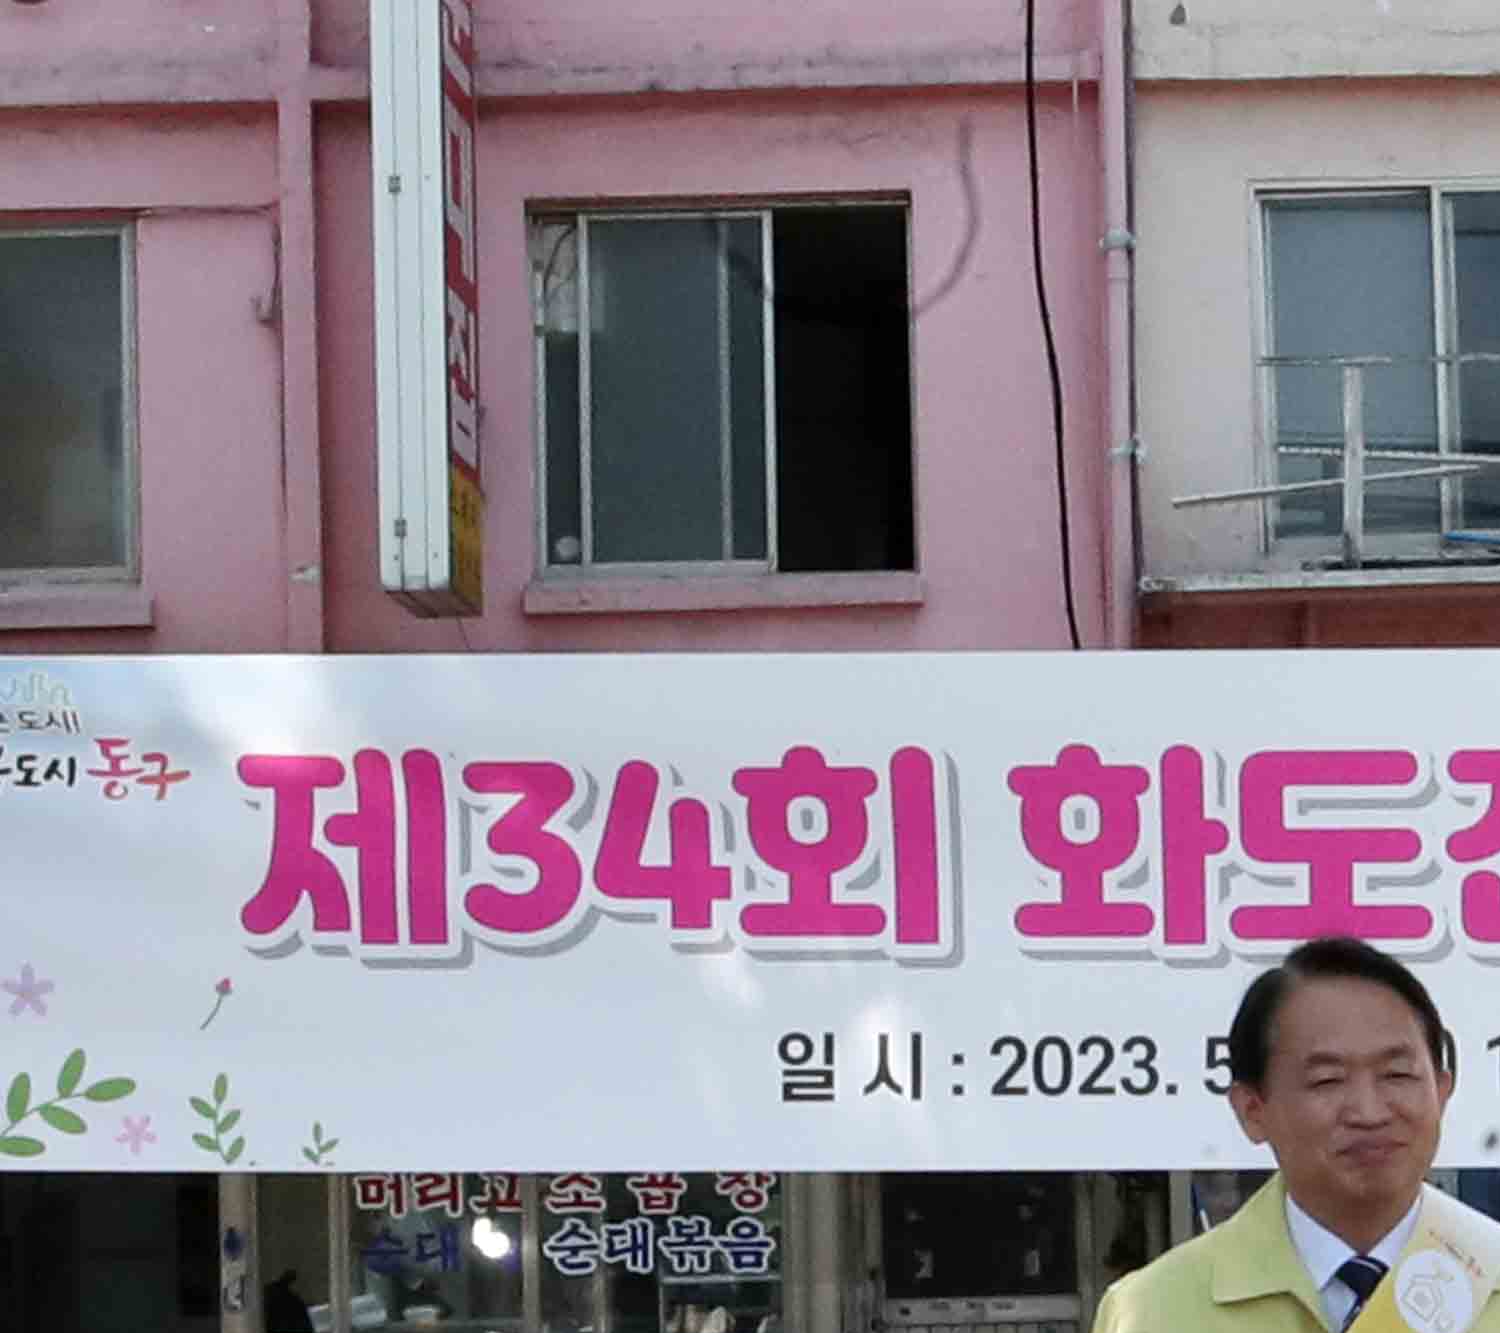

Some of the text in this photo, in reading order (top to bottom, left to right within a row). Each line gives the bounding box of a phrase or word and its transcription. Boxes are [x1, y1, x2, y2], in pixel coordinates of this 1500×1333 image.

[0, 737, 191, 801] 도시 동구
[237, 742, 948, 950] 제34회
[544, 1216, 776, 1277] 순대볶음
